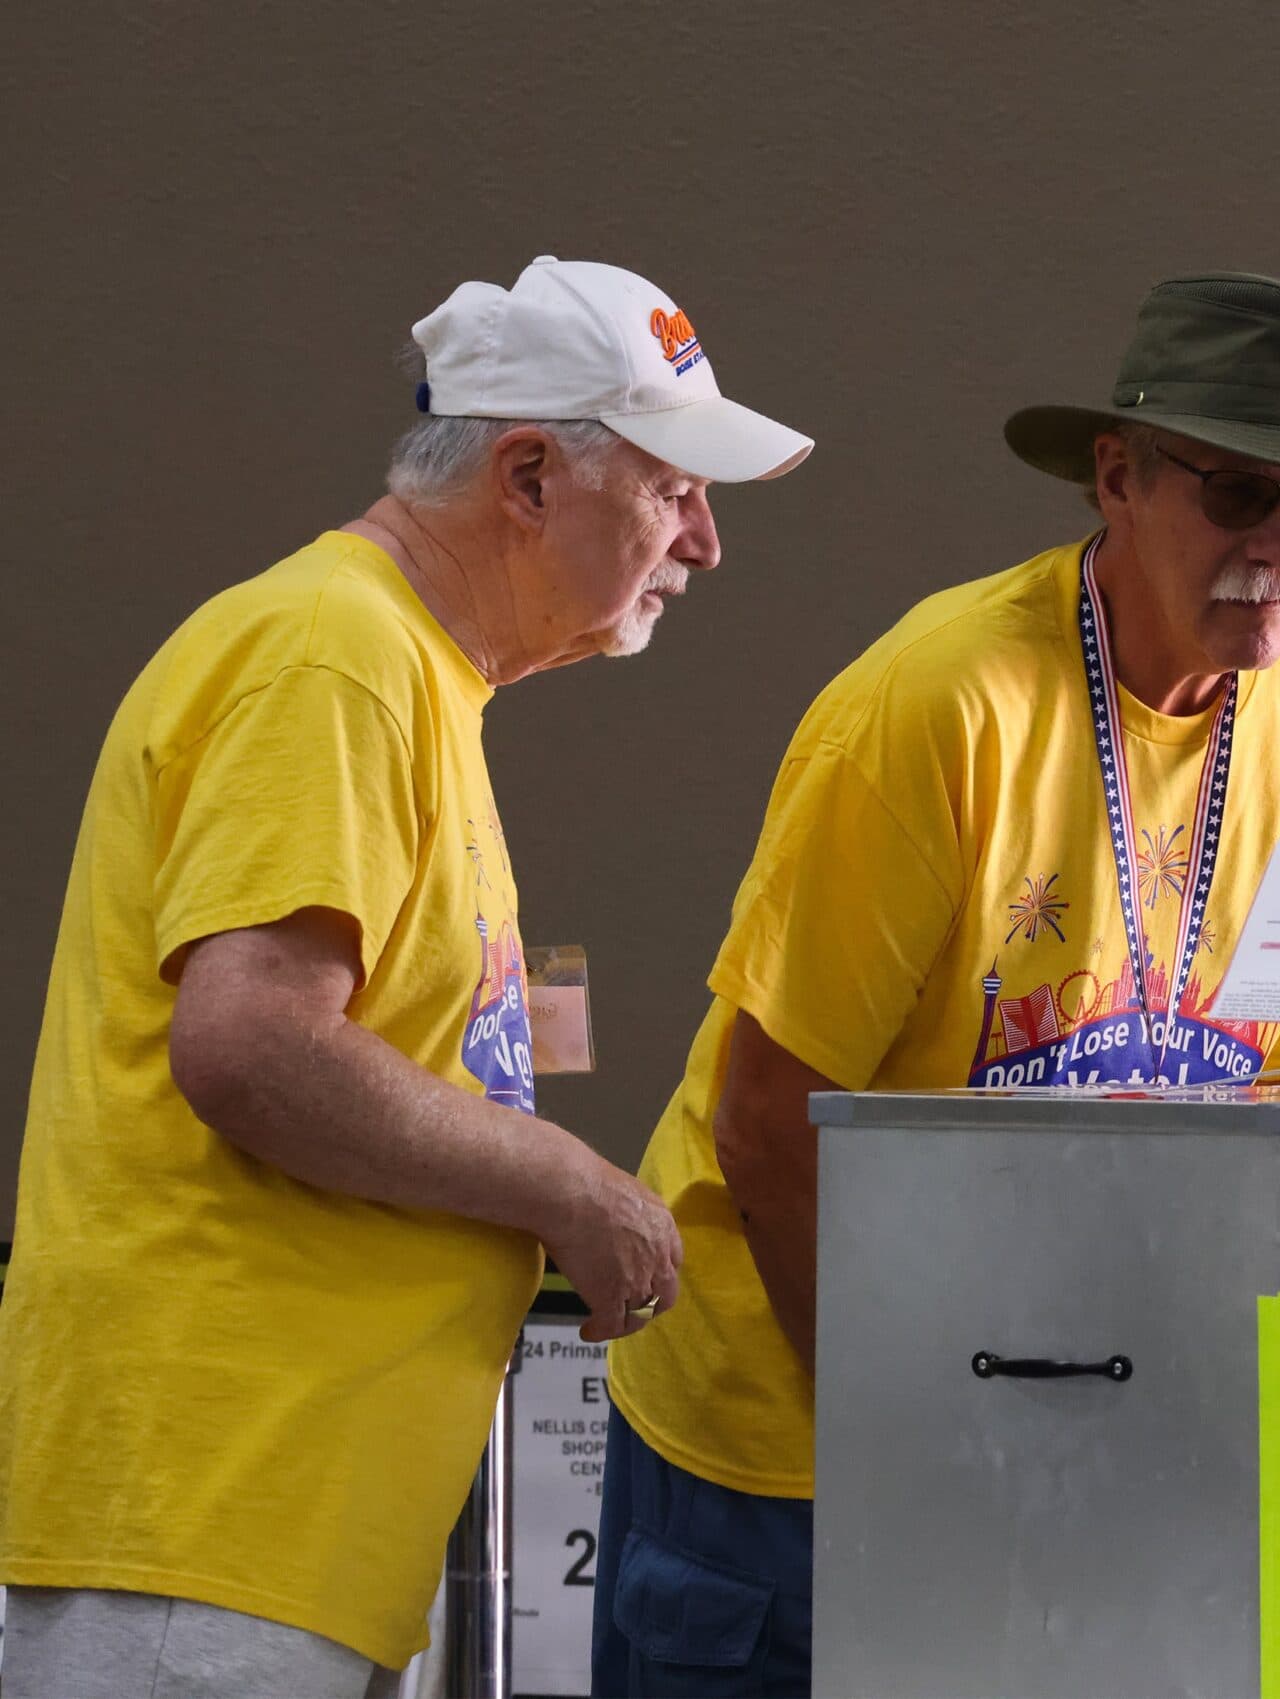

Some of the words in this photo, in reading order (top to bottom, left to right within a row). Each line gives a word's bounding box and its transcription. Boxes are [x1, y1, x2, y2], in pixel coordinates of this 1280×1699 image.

[985, 1044, 1068, 1087] Don't
[1070, 1022, 1129, 1061] Lose
[1139, 1013, 1195, 1052] Your
[1203, 1028, 1252, 1076] Voice
[523, 1341, 544, 1358] 24
[533, 1420, 585, 1434] NELLIS
[562, 1440, 606, 1455] SHOP
[570, 1462, 605, 1476] CEN
